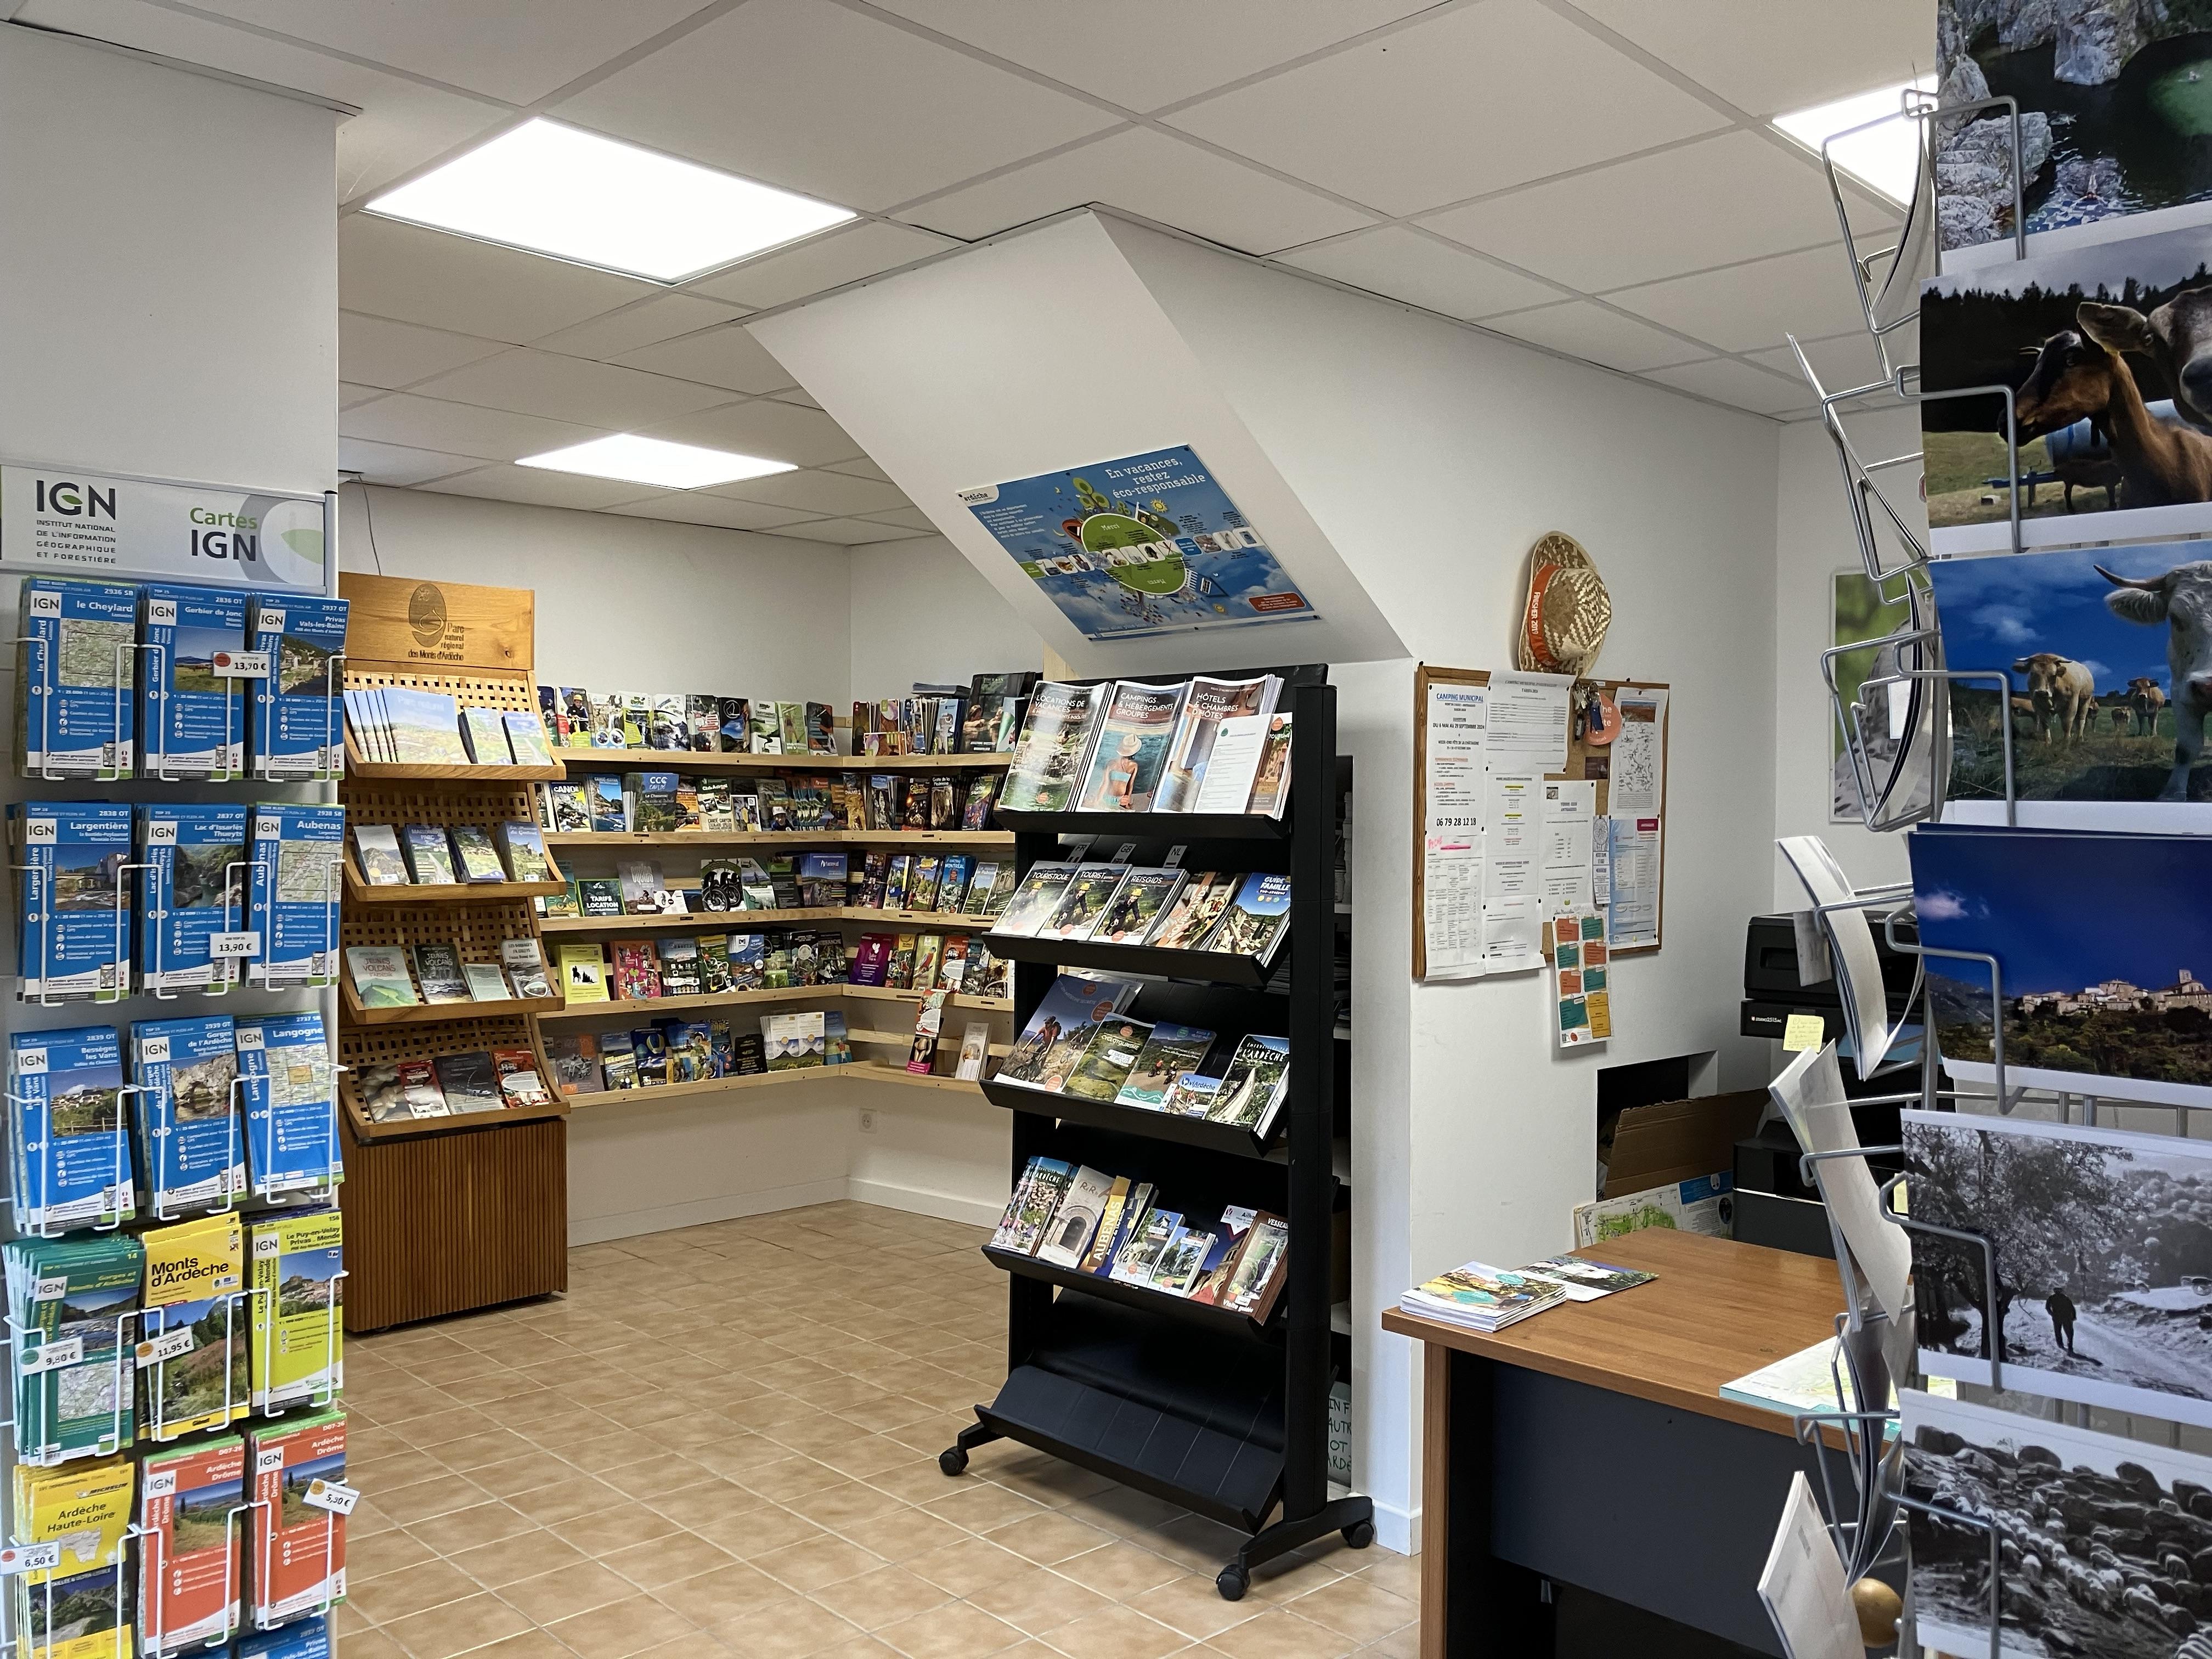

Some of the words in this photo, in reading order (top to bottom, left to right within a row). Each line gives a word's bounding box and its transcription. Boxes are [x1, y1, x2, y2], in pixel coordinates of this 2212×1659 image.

[1105, 469, 1124, 479] En
[1124, 458, 1183, 475] vacances,
[1133, 472, 1170, 485] restez
[1112, 474, 1206, 499] éco-responsable
[36, 480, 116, 520] IGN
[190, 507, 258, 530] Cartes
[36, 520, 72, 528] INSTITUT
[75, 523, 116, 532] NATIONAL
[52, 532, 116, 543] L'INFORMATION
[36, 541, 116, 553] GÉOGRAPHIQUE
[191, 529, 257, 562] IGN
[33, 597, 59, 609] IGN
[77, 600, 86, 609] le
[89, 602, 133, 612] Cheylard
[151, 606, 174, 618] IGN
[185, 606, 213, 616] Gerbier
[261, 614, 284, 625] IGN
[299, 620, 345, 629] Vals-les-Bains
[447, 622, 465, 634] Parc
[441, 641, 465, 650] régional
[419, 650, 436, 659] Monts
[1036, 695, 1076, 707] LOCATIONS
[1121, 692, 1156, 703] CAMPINGS
[1197, 692, 1226, 703] HÔTELS
[1035, 702, 1071, 713] VACANCES
[1201, 702, 1239, 712] CHAMBRES
[1116, 708, 1149, 719] GROUPES
[1192, 709, 1223, 719] D'HÔTES
[70, 822, 128, 831] Largentière
[257, 822, 279, 832] IGN
[297, 821, 341, 830] Aubenas
[1436, 818, 1443, 826] 06
[1444, 818, 1453, 826] 79
[1454, 818, 1462, 826] 28
[1470, 817, 1476, 826] 18
[29, 825, 54, 836] IGN
[151, 827, 175, 838] IGN
[1120, 845, 1133, 853] GB
[1171, 847, 1182, 856] NL
[256, 843, 267, 886] Aubnas
[1032, 872, 1070, 881] TOURISTIQUE
[1131, 876, 1163, 884] REISGIDS
[1260, 882, 1290, 891] FAMILLE
[219, 944, 244, 952] 13,90
[362, 964, 396, 973] VOLCANS
[207, 1030, 232, 1039] Gorges
[240, 1032, 262, 1043] IGN
[273, 1028, 324, 1039] Langogne
[200, 1036, 233, 1046] l'Ardèche
[1101, 1035, 1140, 1051] CYCLOTOURISME
[81, 1046, 117, 1054] Bessèges
[145, 1043, 168, 1055] IGN
[20, 1054, 46, 1066] IGN
[1242, 1049, 1286, 1062] L'ARDÈCHE
[296, 1227, 340, 1239] Puy-en-Velay
[1093, 1201, 1121, 1261] AUBENAS
[256, 1239, 278, 1251] IGN
[290, 1238, 311, 1246] Privas
[317, 1233, 340, 1242] Mende
[151, 1257, 198, 1276] Monts
[151, 1262, 229, 1288] d'Ardèche
[38, 1283, 65, 1294] IGN
[1223, 1299, 1239, 1310] Visite
[157, 1342, 184, 1357] 11,95
[184, 1339, 191, 1347] €
[70, 1352, 76, 1360] €
[311, 1435, 345, 1449] Ardèche
[317, 1443, 344, 1455] Drôme
[259, 1453, 281, 1467] IGN
[206, 1460, 242, 1474] Ardèche
[212, 1469, 241, 1482] Drôme
[150, 1476, 174, 1491] IGN
[58, 1502, 106, 1520] Ardèche
[47, 1511, 116, 1533] Haute-Loire
[24, 1557, 45, 1567] 6,50
[48, 1555, 55, 1563] €
